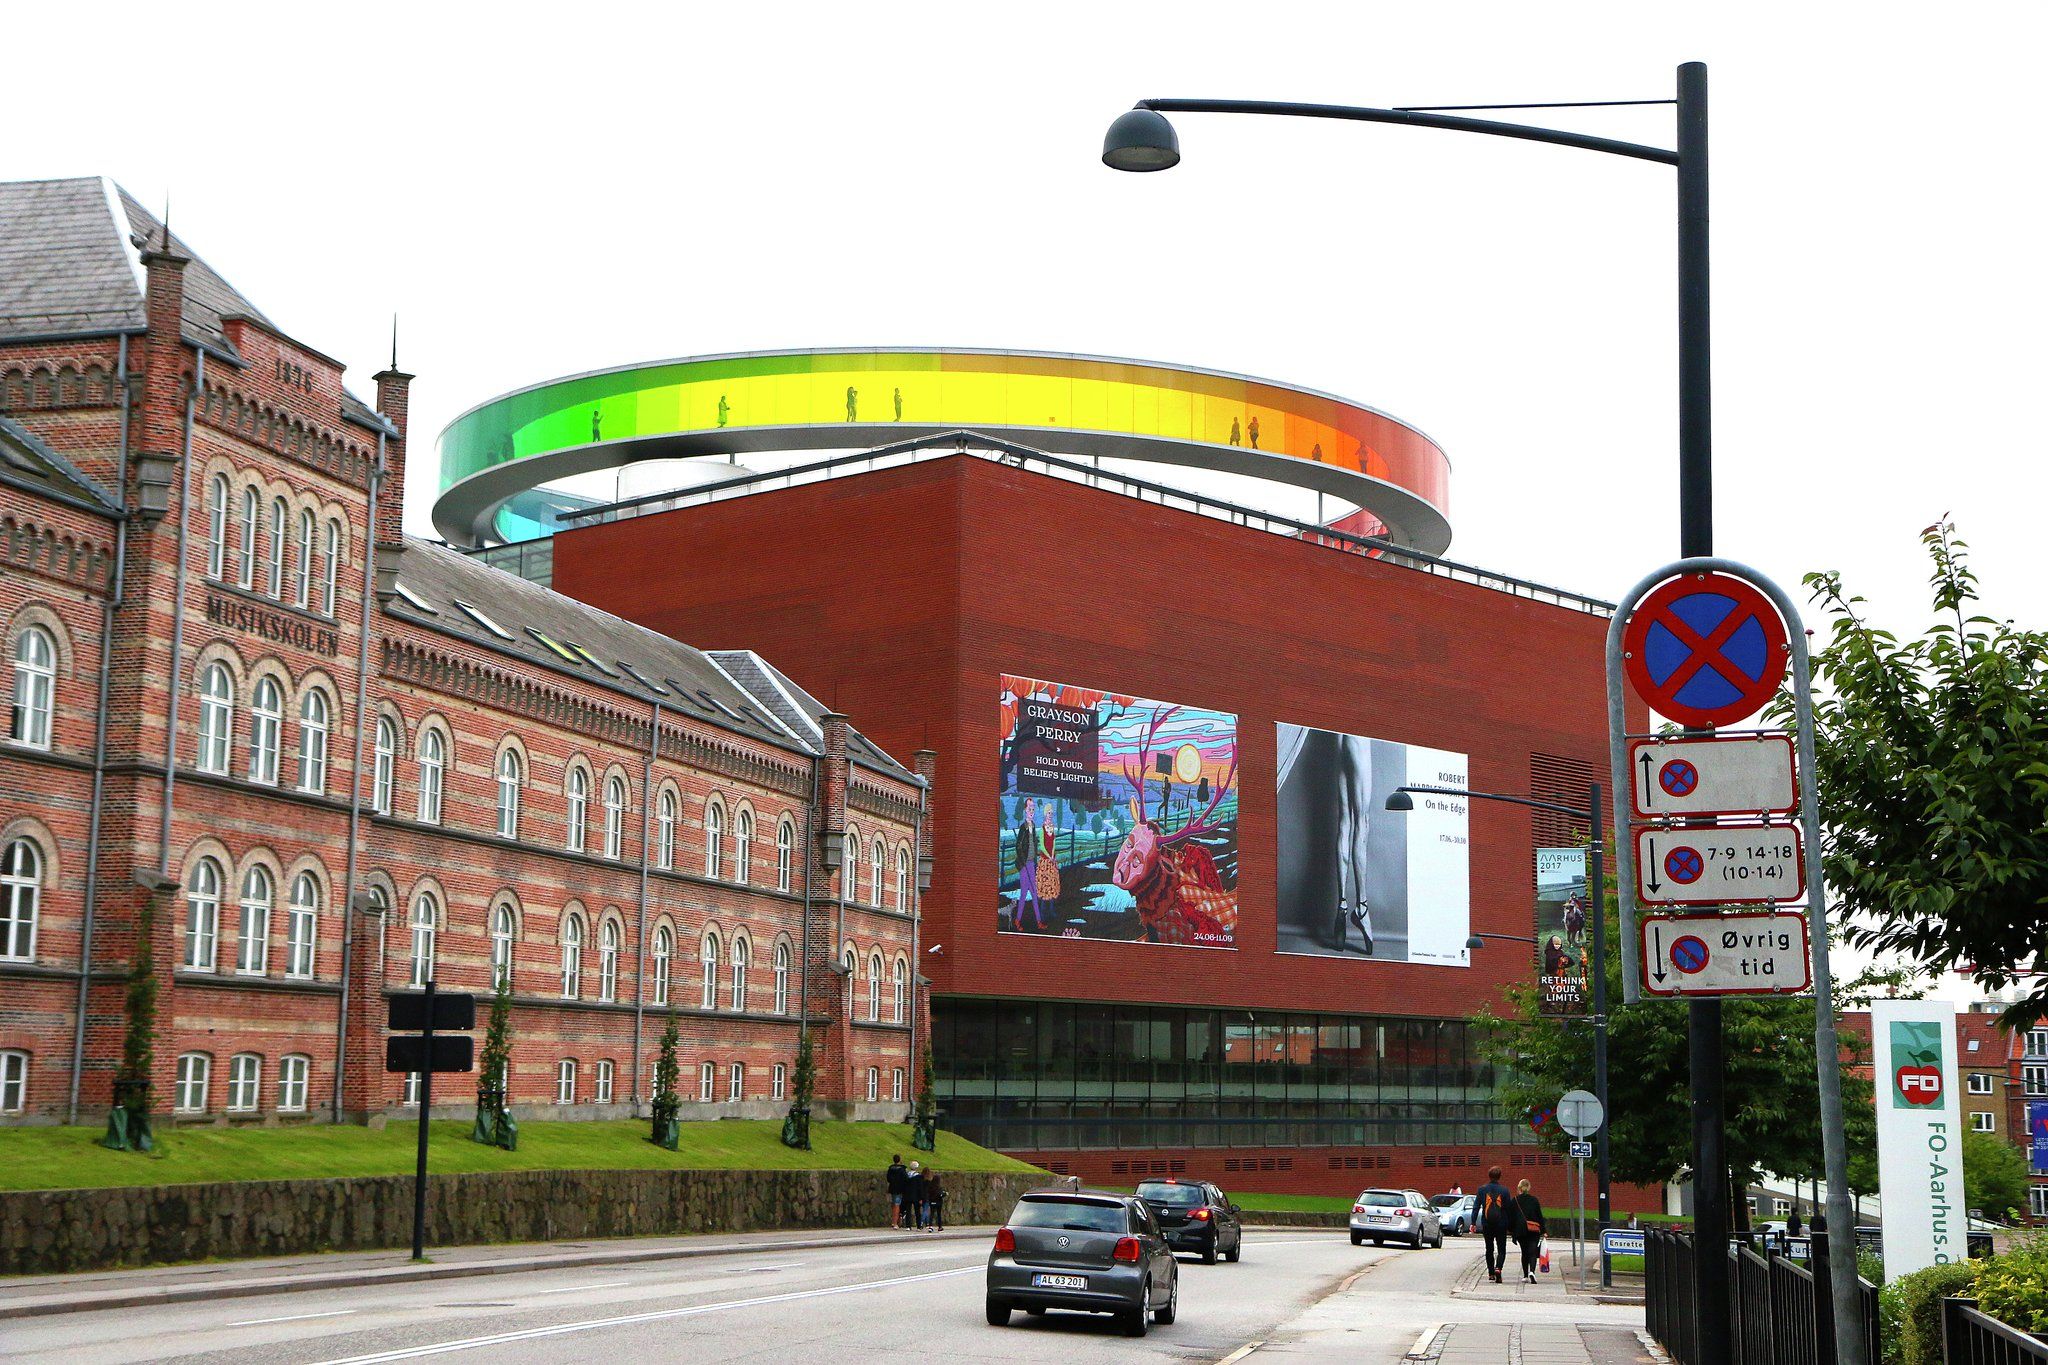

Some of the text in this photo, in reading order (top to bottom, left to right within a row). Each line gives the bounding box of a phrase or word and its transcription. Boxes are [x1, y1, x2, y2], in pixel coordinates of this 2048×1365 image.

[207, 594, 339, 659] MUSIKSKOLEN
[1027, 705, 1091, 726] GRAYSON
[1036, 725, 1082, 744] PERRY
[1036, 756, 1083, 771] HOLD YOUR
[1023, 767, 1095, 785] BELIEFS LIGHTLY
[1438, 772, 1466, 785] ROBERT
[1425, 799, 1466, 816] On the Edge
[1707, 845, 1792, 861] 7-9 14-18
[1540, 862, 1562, 870] 2017
[1722, 864, 1783, 882] (10-14)
[1721, 930, 1790, 951] Øvrig
[1740, 957, 1775, 976] tid
[1541, 976, 1585, 985] RETHINK
[1549, 985, 1577, 993] YOUR
[1546, 993, 1580, 1002] LIMITS
[1901, 1074, 1940, 1092] FO
[1927, 1122, 1952, 1267] FO-Aarhus.d
[1610, 1239, 1644, 1249] Ensrette
[1041, 1276, 1053, 1285] AL
[1055, 1276, 1066, 1286] 63
[1067, 1278, 1083, 1287] 201
